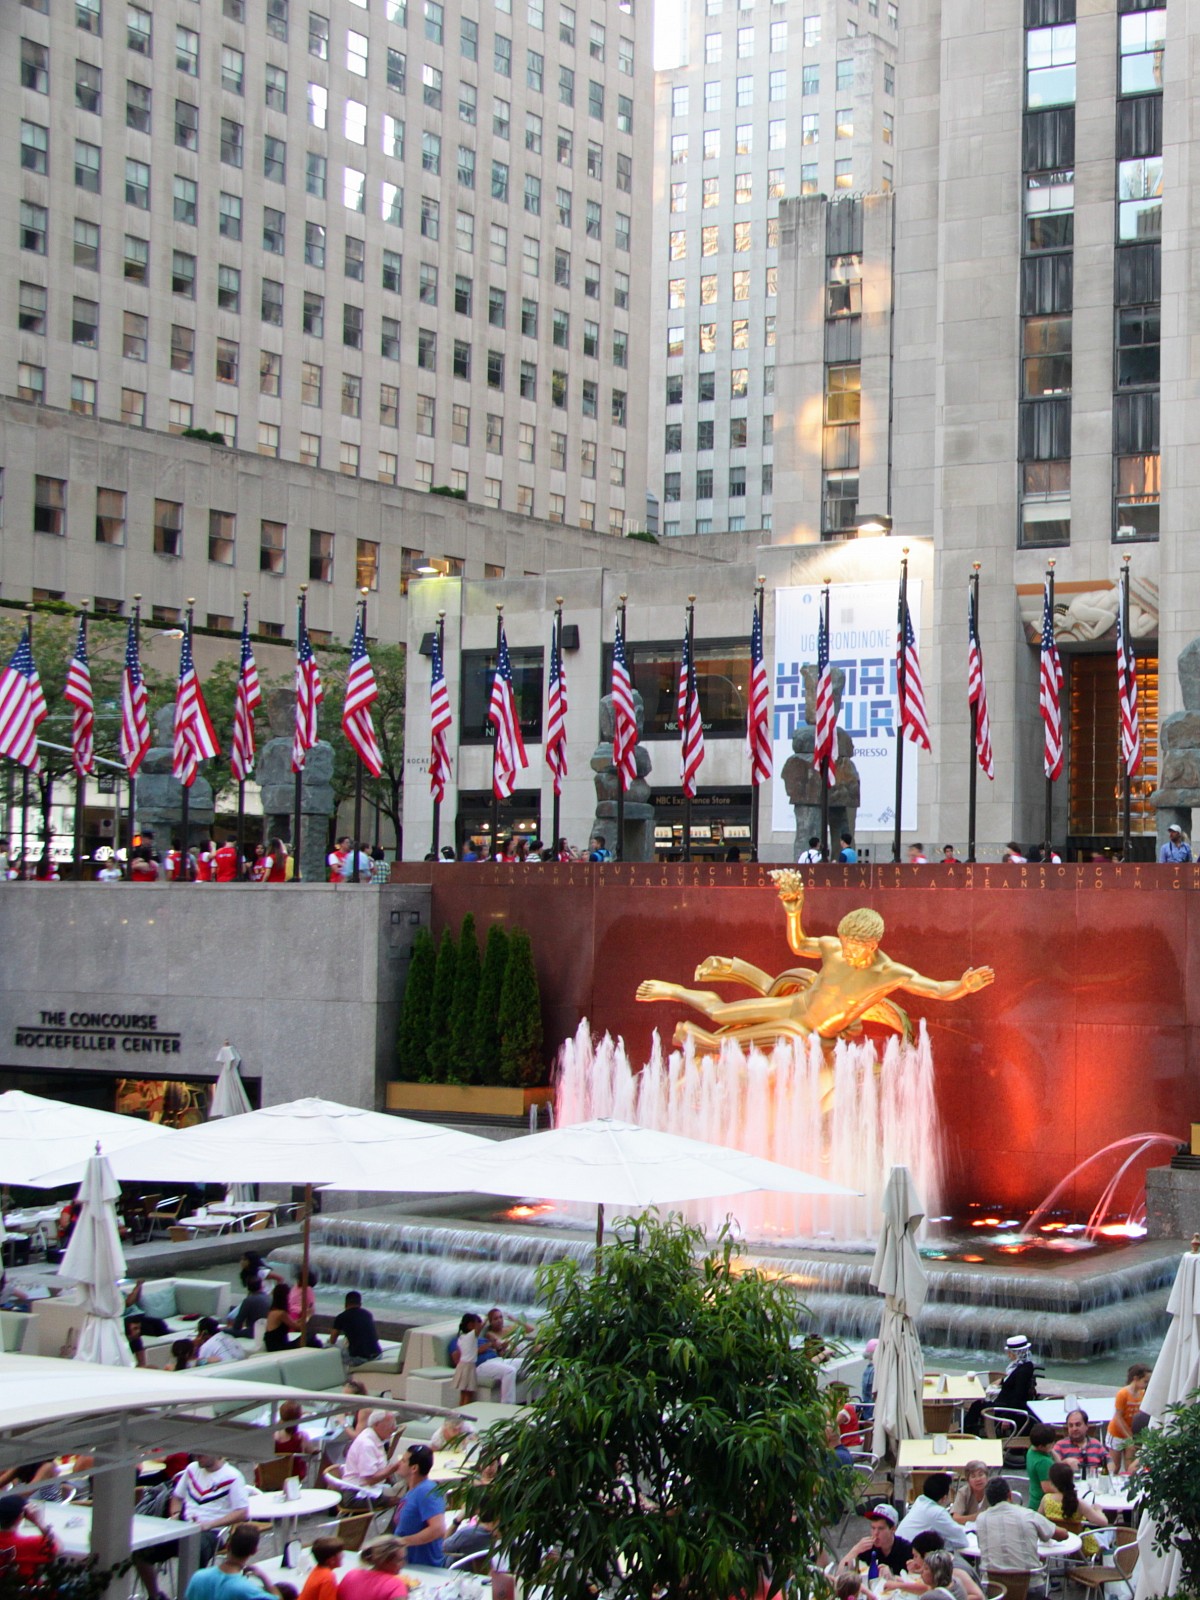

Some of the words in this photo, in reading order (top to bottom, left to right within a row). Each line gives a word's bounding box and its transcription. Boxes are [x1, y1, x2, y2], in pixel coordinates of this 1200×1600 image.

[801, 633, 818, 653] UG
[829, 629, 891, 651] RONDINONE
[776, 658, 897, 699] HMA
[664, 722, 679, 731] NBC
[854, 747, 888, 758] PRESSO
[656, 796, 671, 805] NBC
[672, 796, 710, 806] Expence
[711, 795, 731, 805] Store
[494, 866, 636, 875] PROMETHEUS
[661, 866, 765, 876] TEACHER
[843, 867, 920, 876] EVERY
[947, 867, 990, 876] ART
[1021, 866, 1141, 877] BROUGHT
[479, 876, 529, 885] THAT
[553, 877, 605, 886] HATH
[630, 878, 715, 887] PROVED
[742, 878, 765, 887] TO
[808, 879, 901, 888] ORTALS
[930, 879, 937, 888] A
[965, 879, 1046, 889] MEANS
[1077, 879, 1103, 889] TO
[40, 1011, 66, 1027] THE
[70, 1012, 157, 1030] CONCOURSE
[15, 1033, 116, 1051] ROCKEFELLER
[122, 1037, 181, 1054] CENTER
